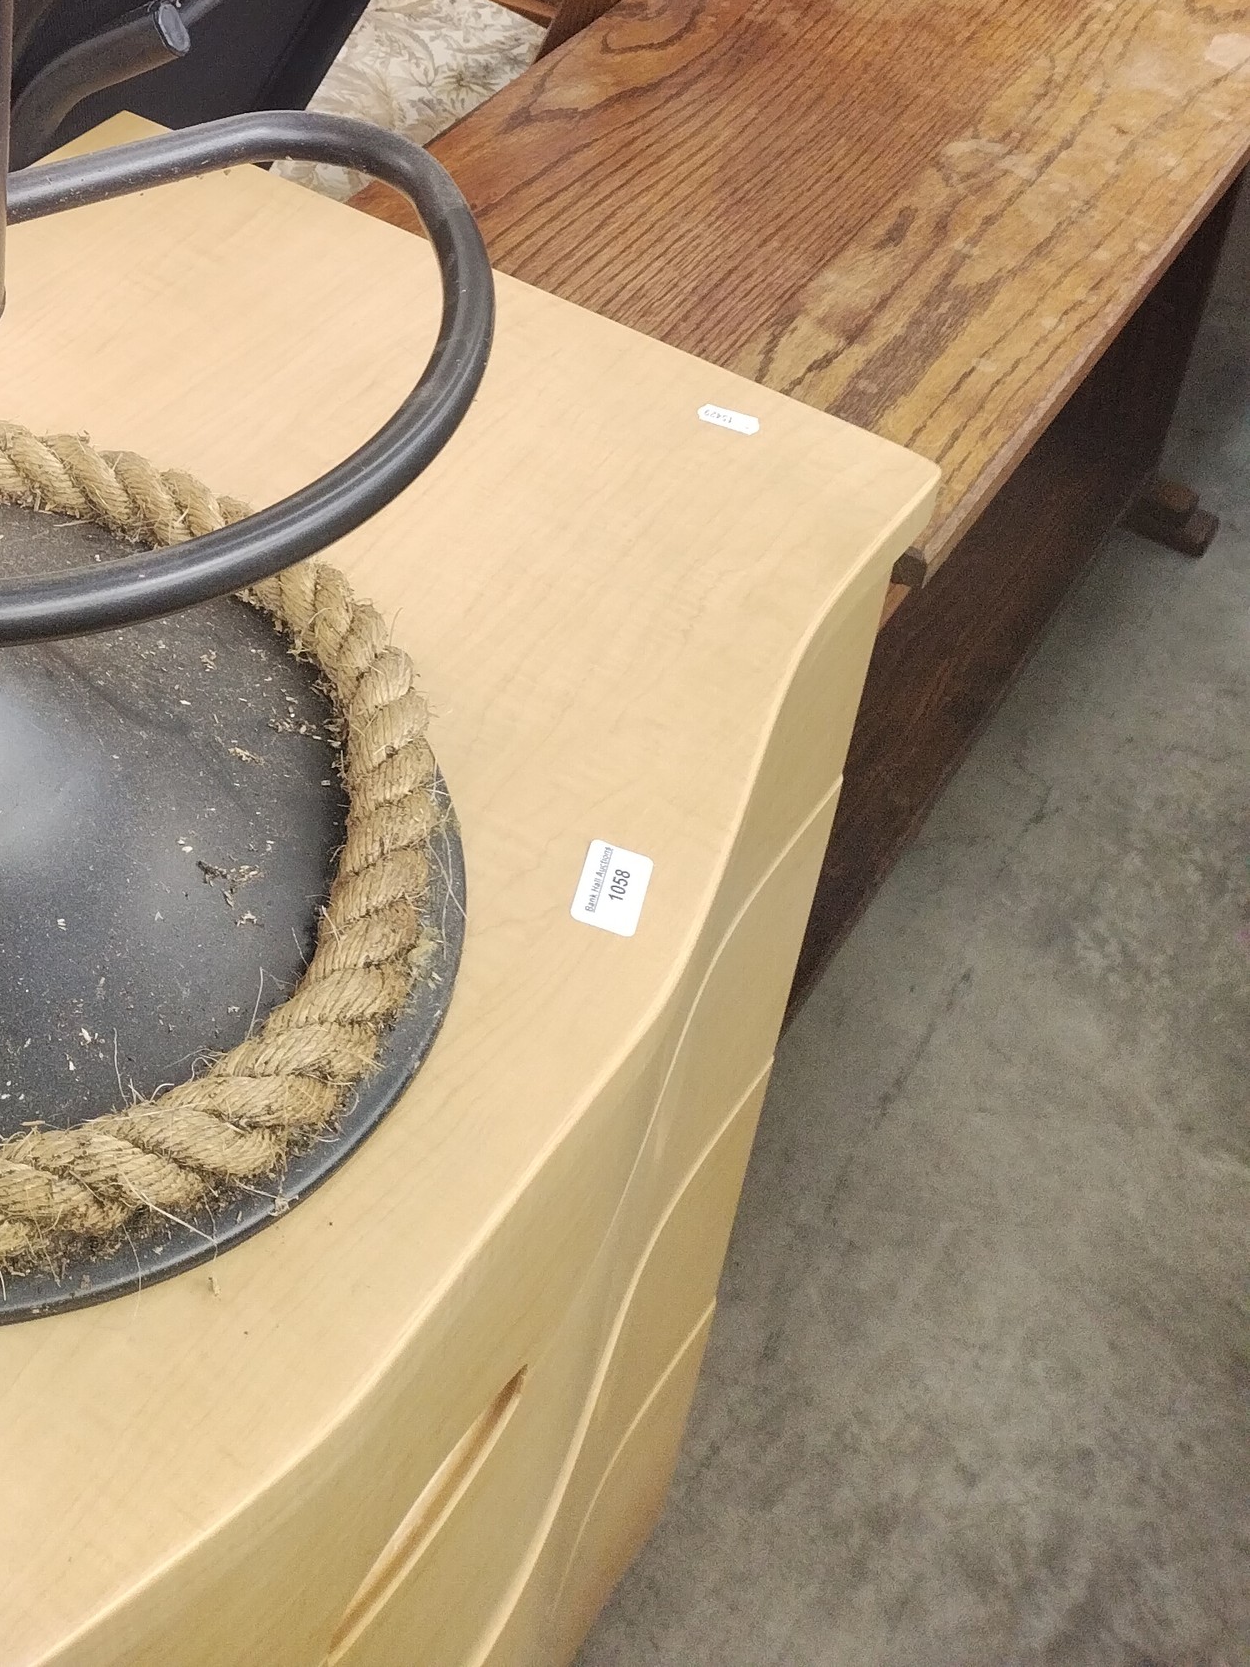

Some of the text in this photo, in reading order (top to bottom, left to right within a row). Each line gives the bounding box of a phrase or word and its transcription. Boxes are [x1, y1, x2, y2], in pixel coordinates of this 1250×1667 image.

[585, 847, 613, 912] Bank Hall Auctions
[608, 869, 630, 900] 1058
